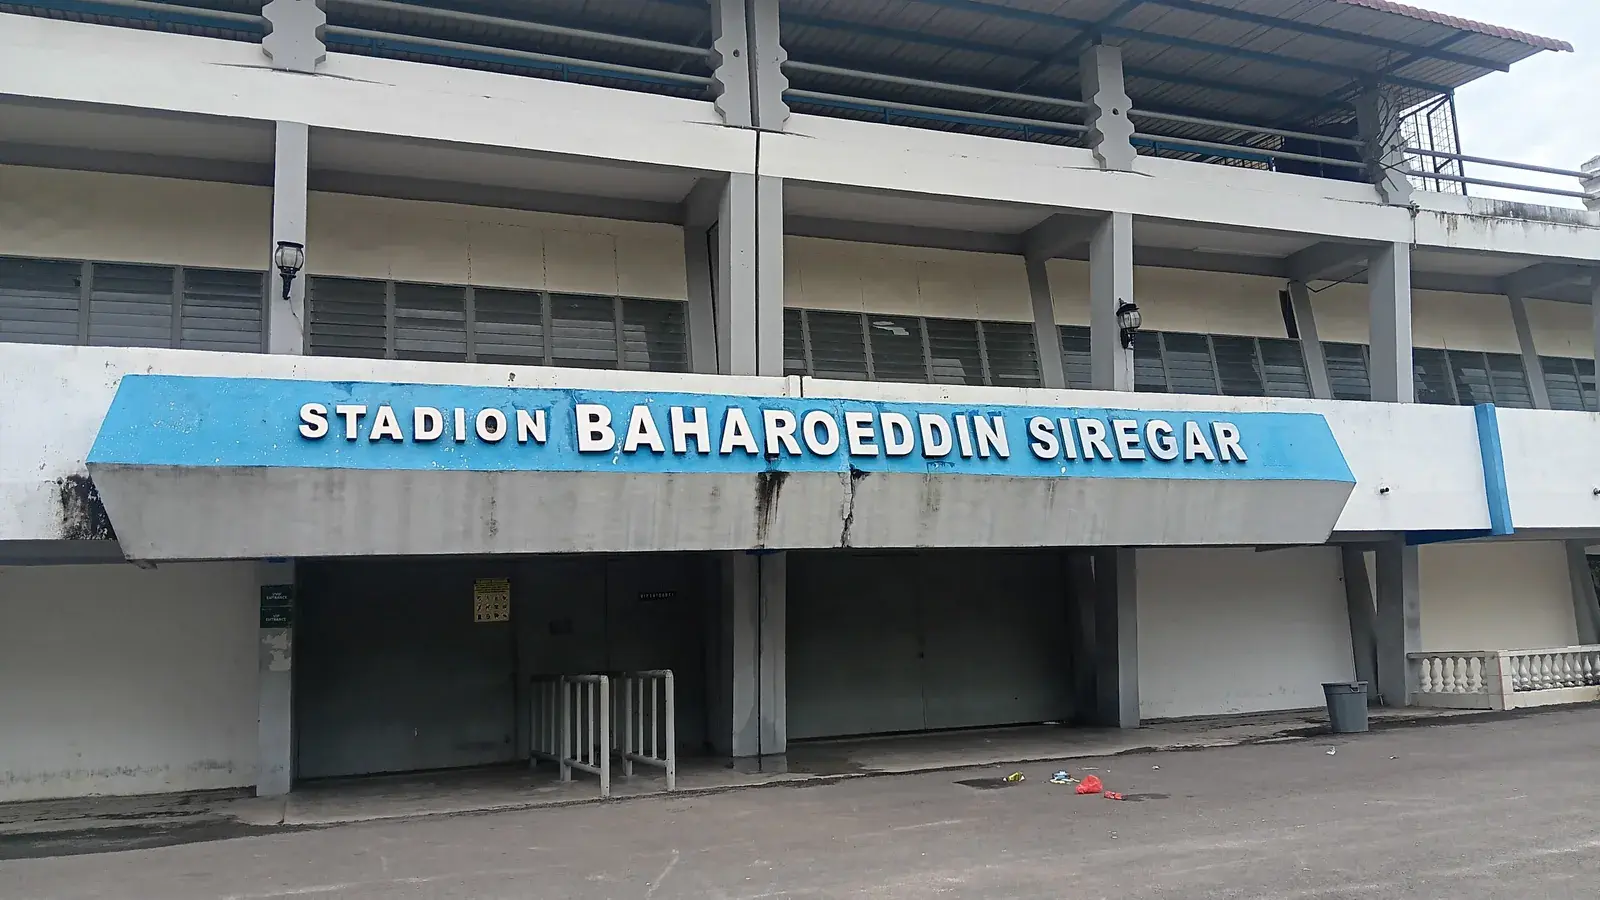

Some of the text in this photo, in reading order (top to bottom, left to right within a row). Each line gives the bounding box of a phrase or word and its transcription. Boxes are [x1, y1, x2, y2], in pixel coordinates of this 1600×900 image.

[298, 402, 1248, 462] STADION BAHAROEDDIN SIREGAR
